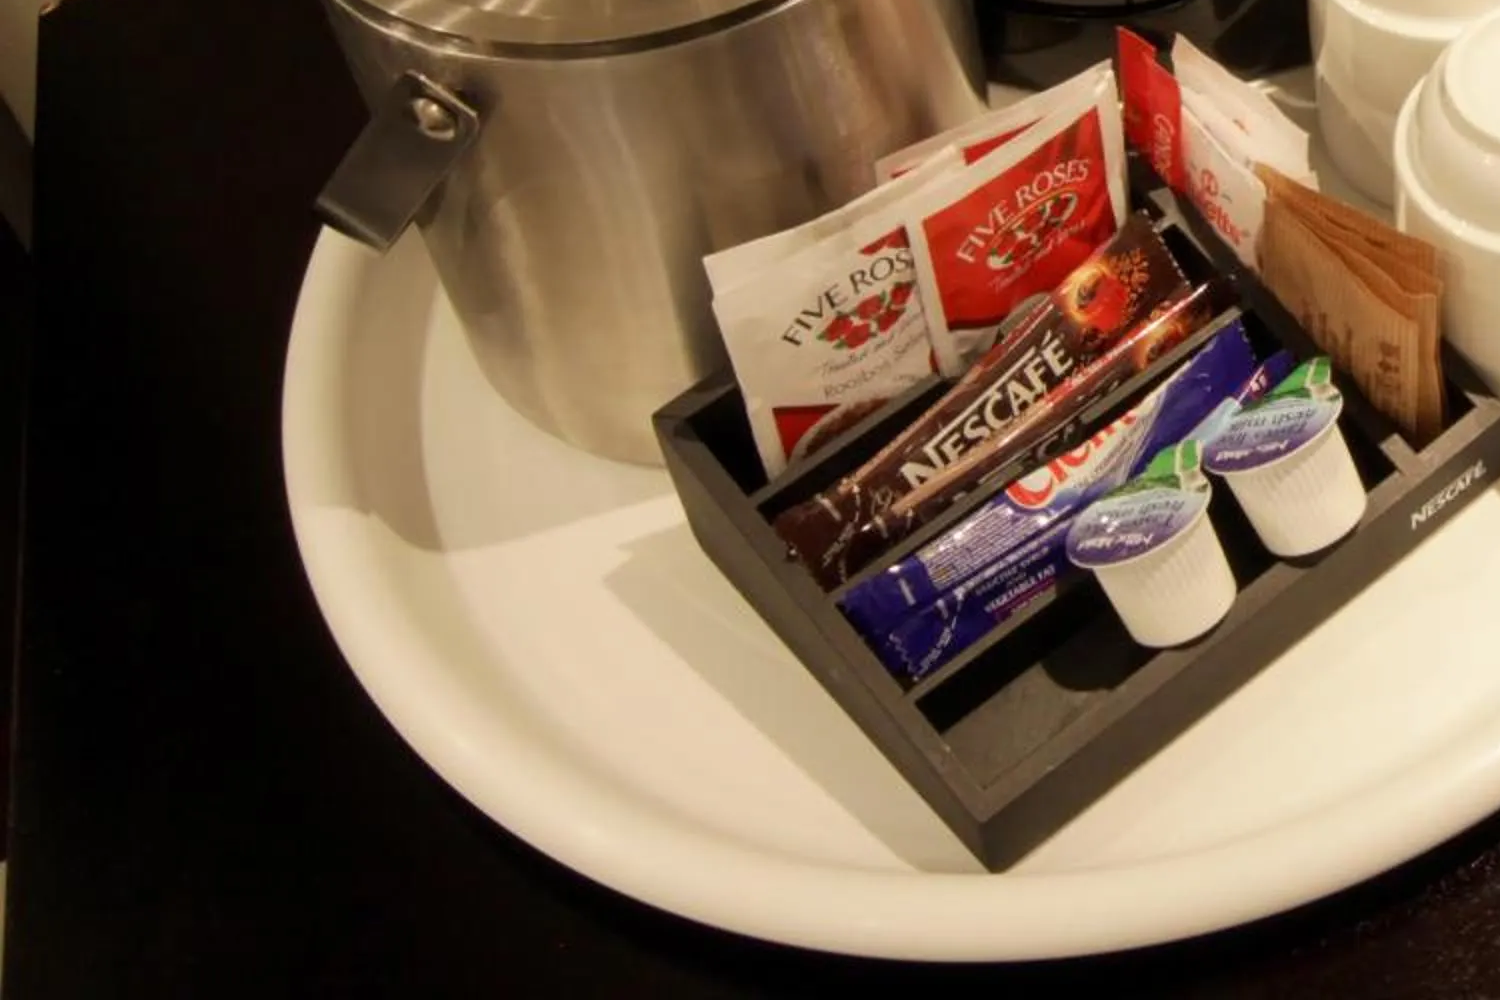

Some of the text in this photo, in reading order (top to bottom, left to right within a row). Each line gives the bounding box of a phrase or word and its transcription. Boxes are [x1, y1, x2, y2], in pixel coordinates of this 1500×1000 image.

[956, 199, 1009, 264] FIVE
[1016, 156, 1093, 205] ROSES
[781, 250, 915, 347] FIVE ROS
[900, 330, 1076, 490] NESCAFÉ
